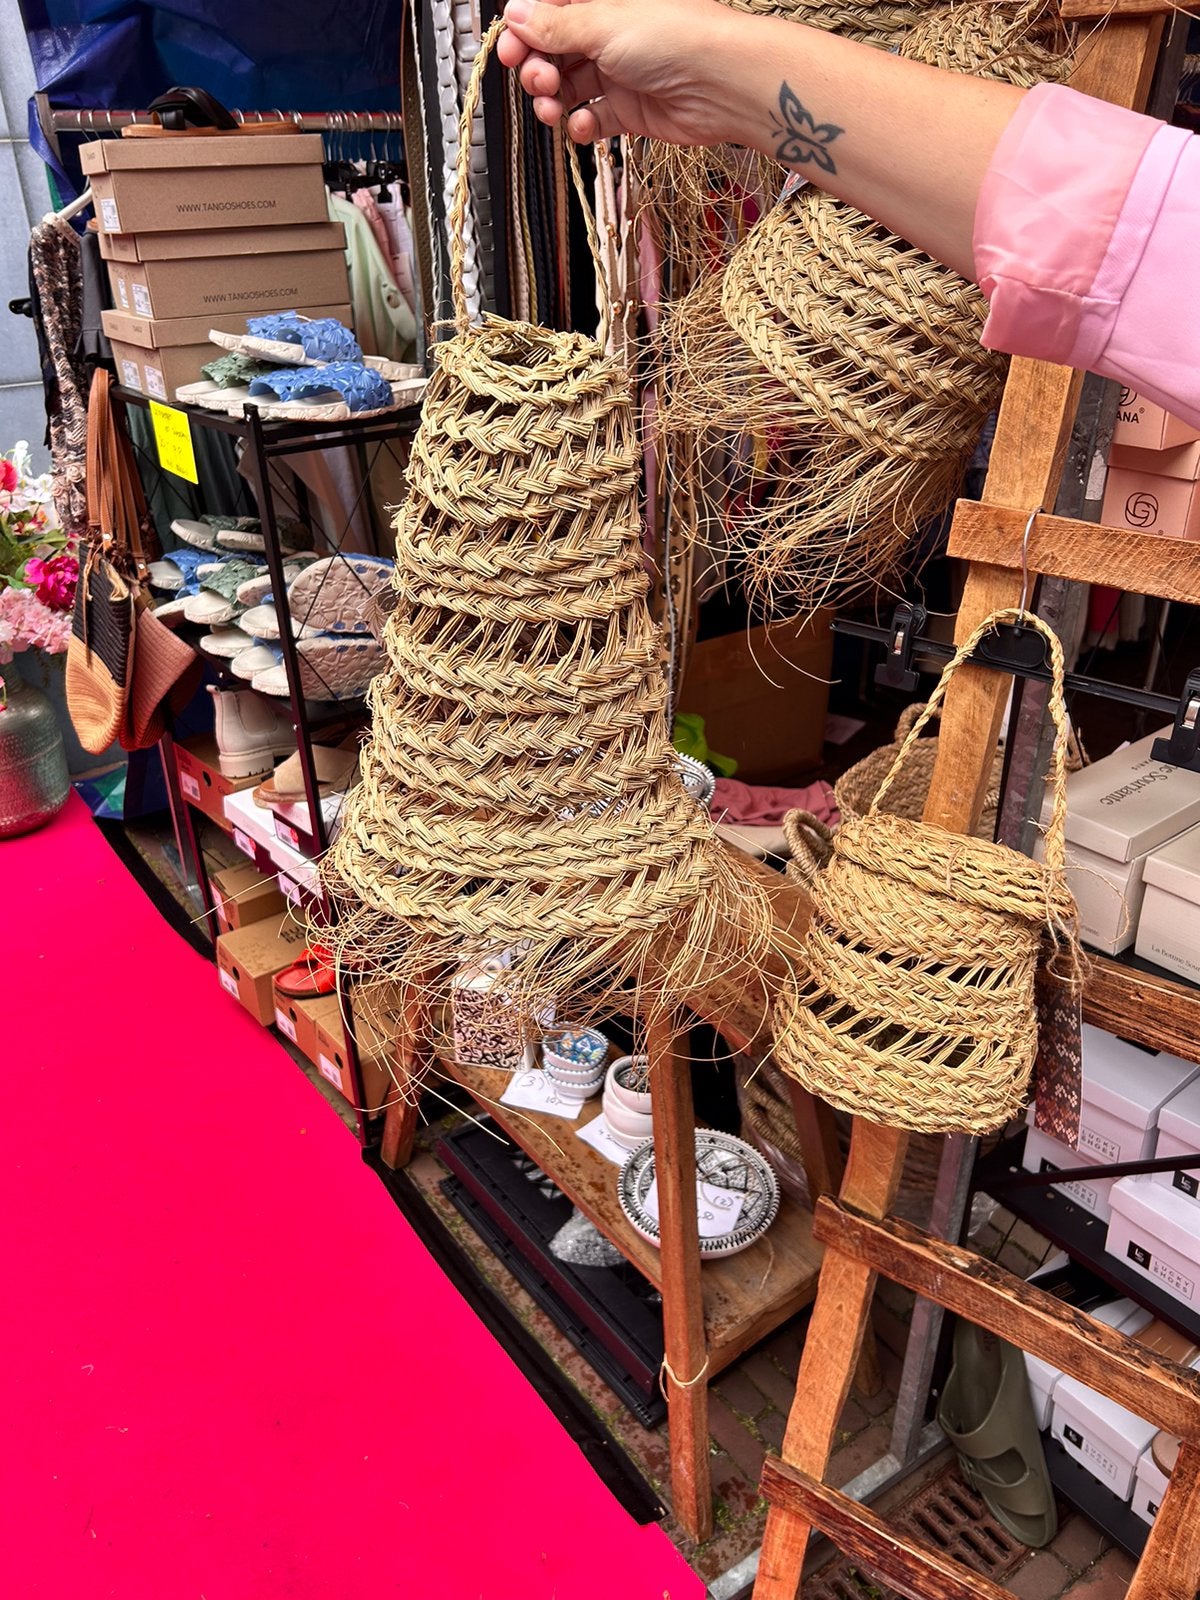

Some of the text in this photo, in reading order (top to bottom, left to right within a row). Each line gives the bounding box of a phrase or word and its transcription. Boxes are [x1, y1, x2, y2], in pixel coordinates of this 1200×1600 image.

[176, 200, 277, 213] WWW.TANGOSHOES.COM
[203, 288, 298, 303] WWW.TANGOSHOES.COM
[1100, 771, 1168, 805] Souriante
[1081, 1135, 1114, 1158] SHOES
[1082, 1129, 1115, 1151] LUCKY
[1153, 1264, 1188, 1293] SHOES
[1155, 1261, 1189, 1287] LUCKY
